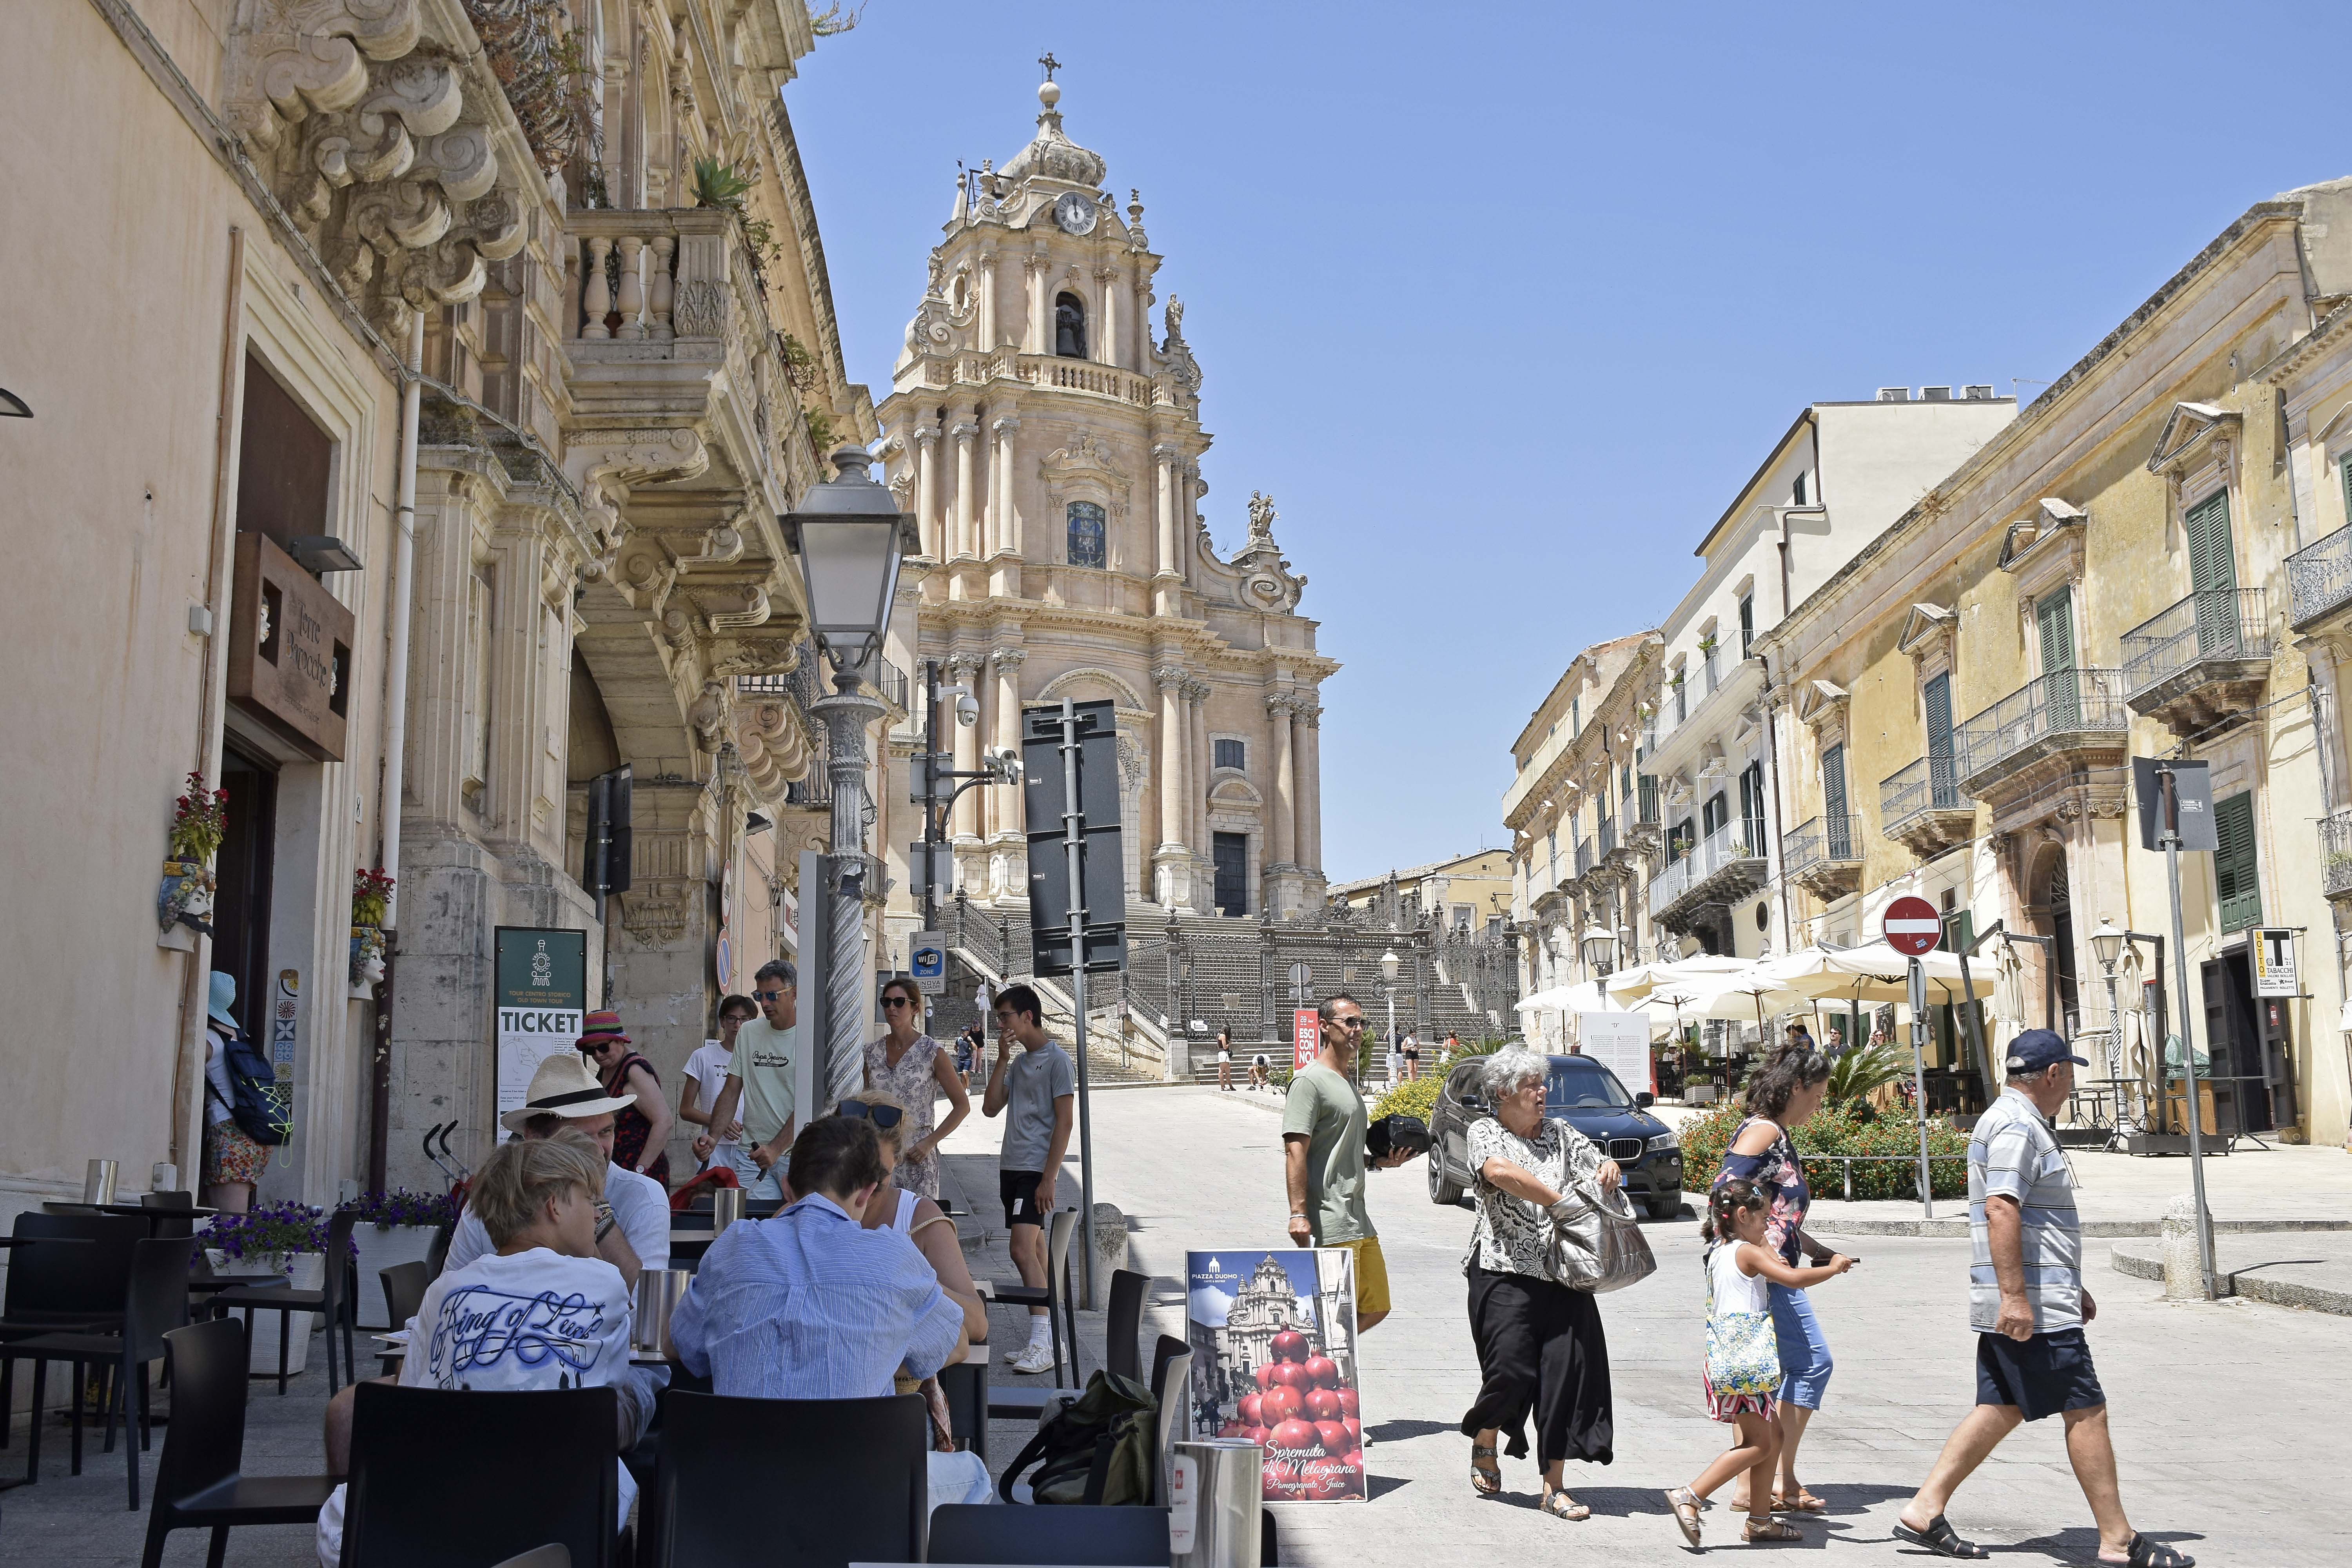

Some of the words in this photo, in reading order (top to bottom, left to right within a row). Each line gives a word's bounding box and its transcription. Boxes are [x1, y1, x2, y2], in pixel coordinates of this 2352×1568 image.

[298, 599, 320, 644] Terre
[286, 628, 326, 689] Barocche
[532, 952, 550, 961] TRENINO
[2256, 932, 2265, 973] LOTTO
[2263, 931, 2290, 966] T
[532, 962, 550, 972] BAROCCO
[501, 1012, 579, 1033] TICKET
[1299, 1028, 1314, 1039] ESCI
[1299, 1039, 1314, 1050] CON
[753, 1051, 768, 1062] Pepe
[767, 1052, 788, 1063] Jeans
[1299, 1050, 1314, 1064] NOI
[1263, 1439, 1326, 1463] Spremuta
[1263, 1459, 1275, 1473] di
[1276, 1457, 1357, 1480] Melograno
[1267, 1478, 1318, 1492] Pomegranate
[1319, 1477, 1345, 1492] Juice
